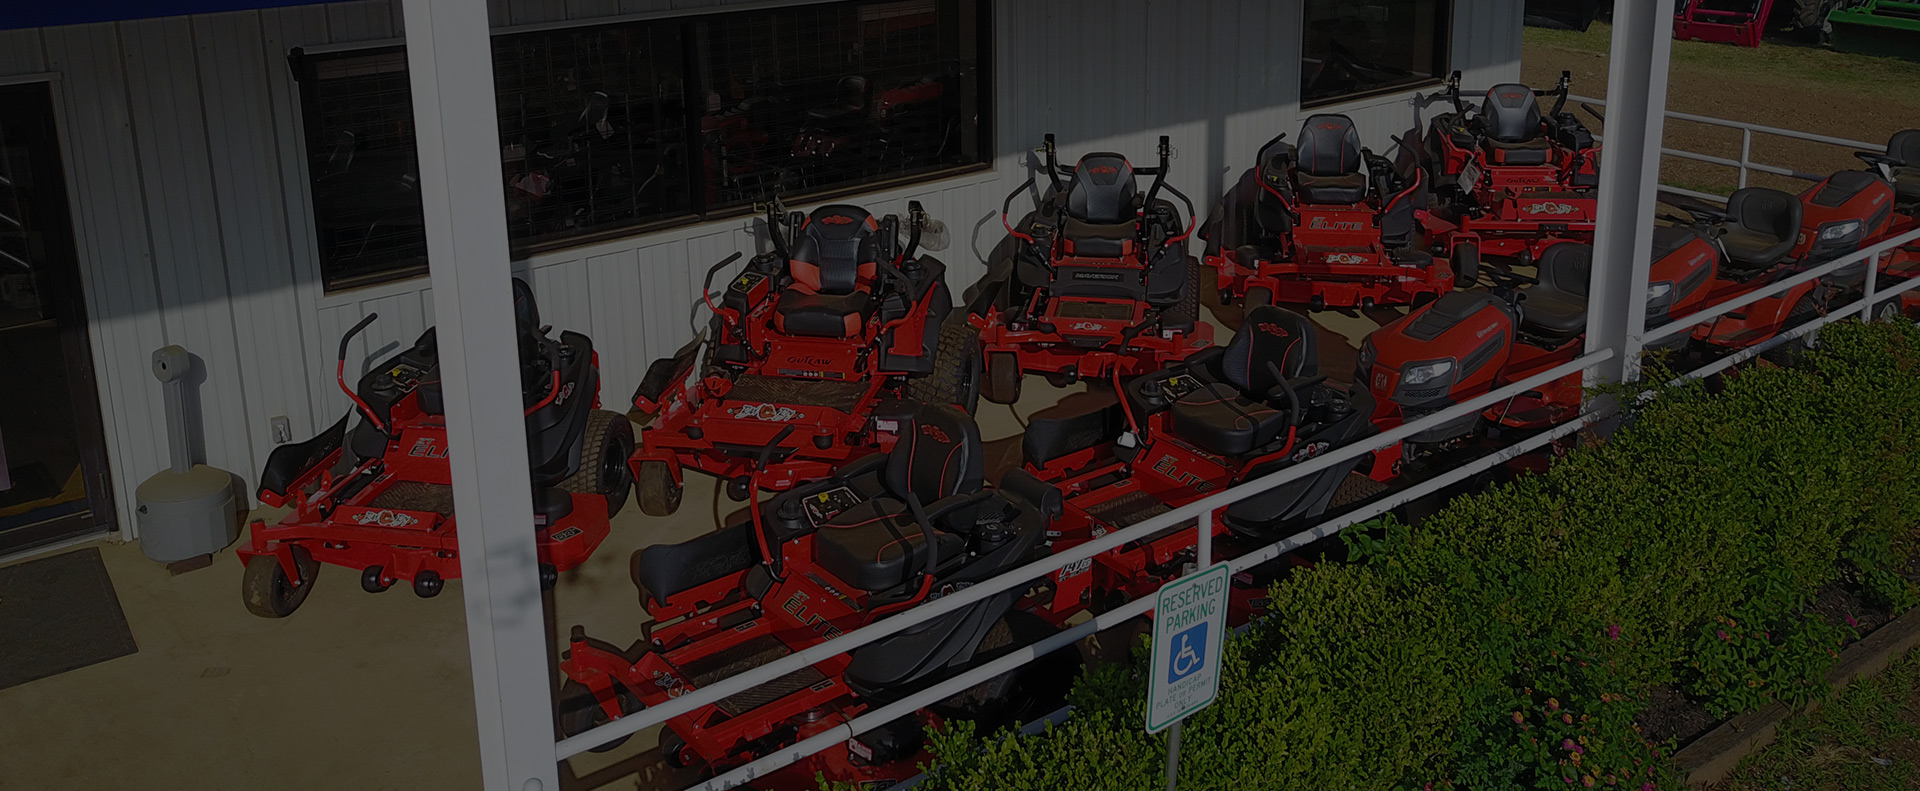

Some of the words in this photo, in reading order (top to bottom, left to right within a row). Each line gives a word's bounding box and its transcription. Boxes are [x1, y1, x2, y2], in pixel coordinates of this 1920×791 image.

[408, 444, 451, 459] ELI
[1152, 459, 1216, 495] ELITE
[1162, 576, 1223, 615] RESERVED
[782, 595, 843, 641] ELITE
[1166, 598, 1216, 634] PARKING
[1156, 693, 1177, 710] PLATE
[1188, 676, 1212, 694] PERMIT
[1168, 673, 1202, 695] HANDICAP
[1174, 694, 1193, 710] ONLY
